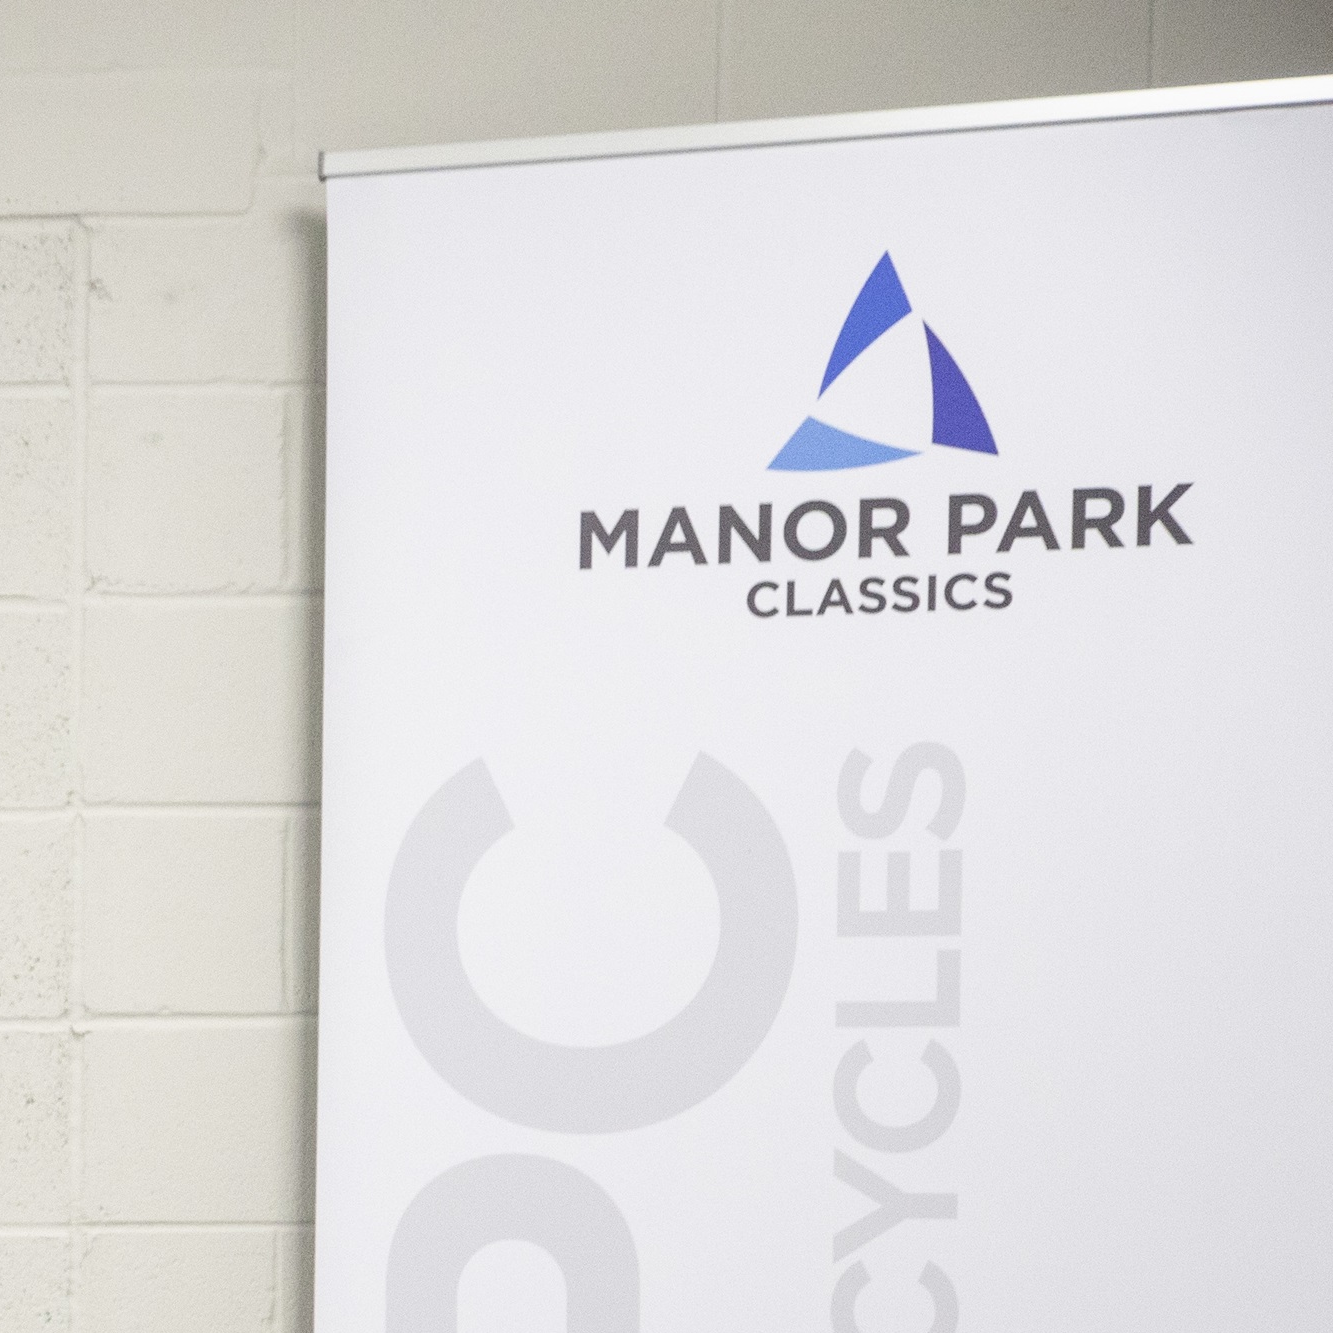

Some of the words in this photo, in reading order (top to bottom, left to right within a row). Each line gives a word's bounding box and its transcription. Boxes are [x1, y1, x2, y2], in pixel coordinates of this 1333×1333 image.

[579, 497, 911, 570] MANOR
[947, 482, 1194, 555] PARK
[746, 571, 1013, 618] CLASSICS
